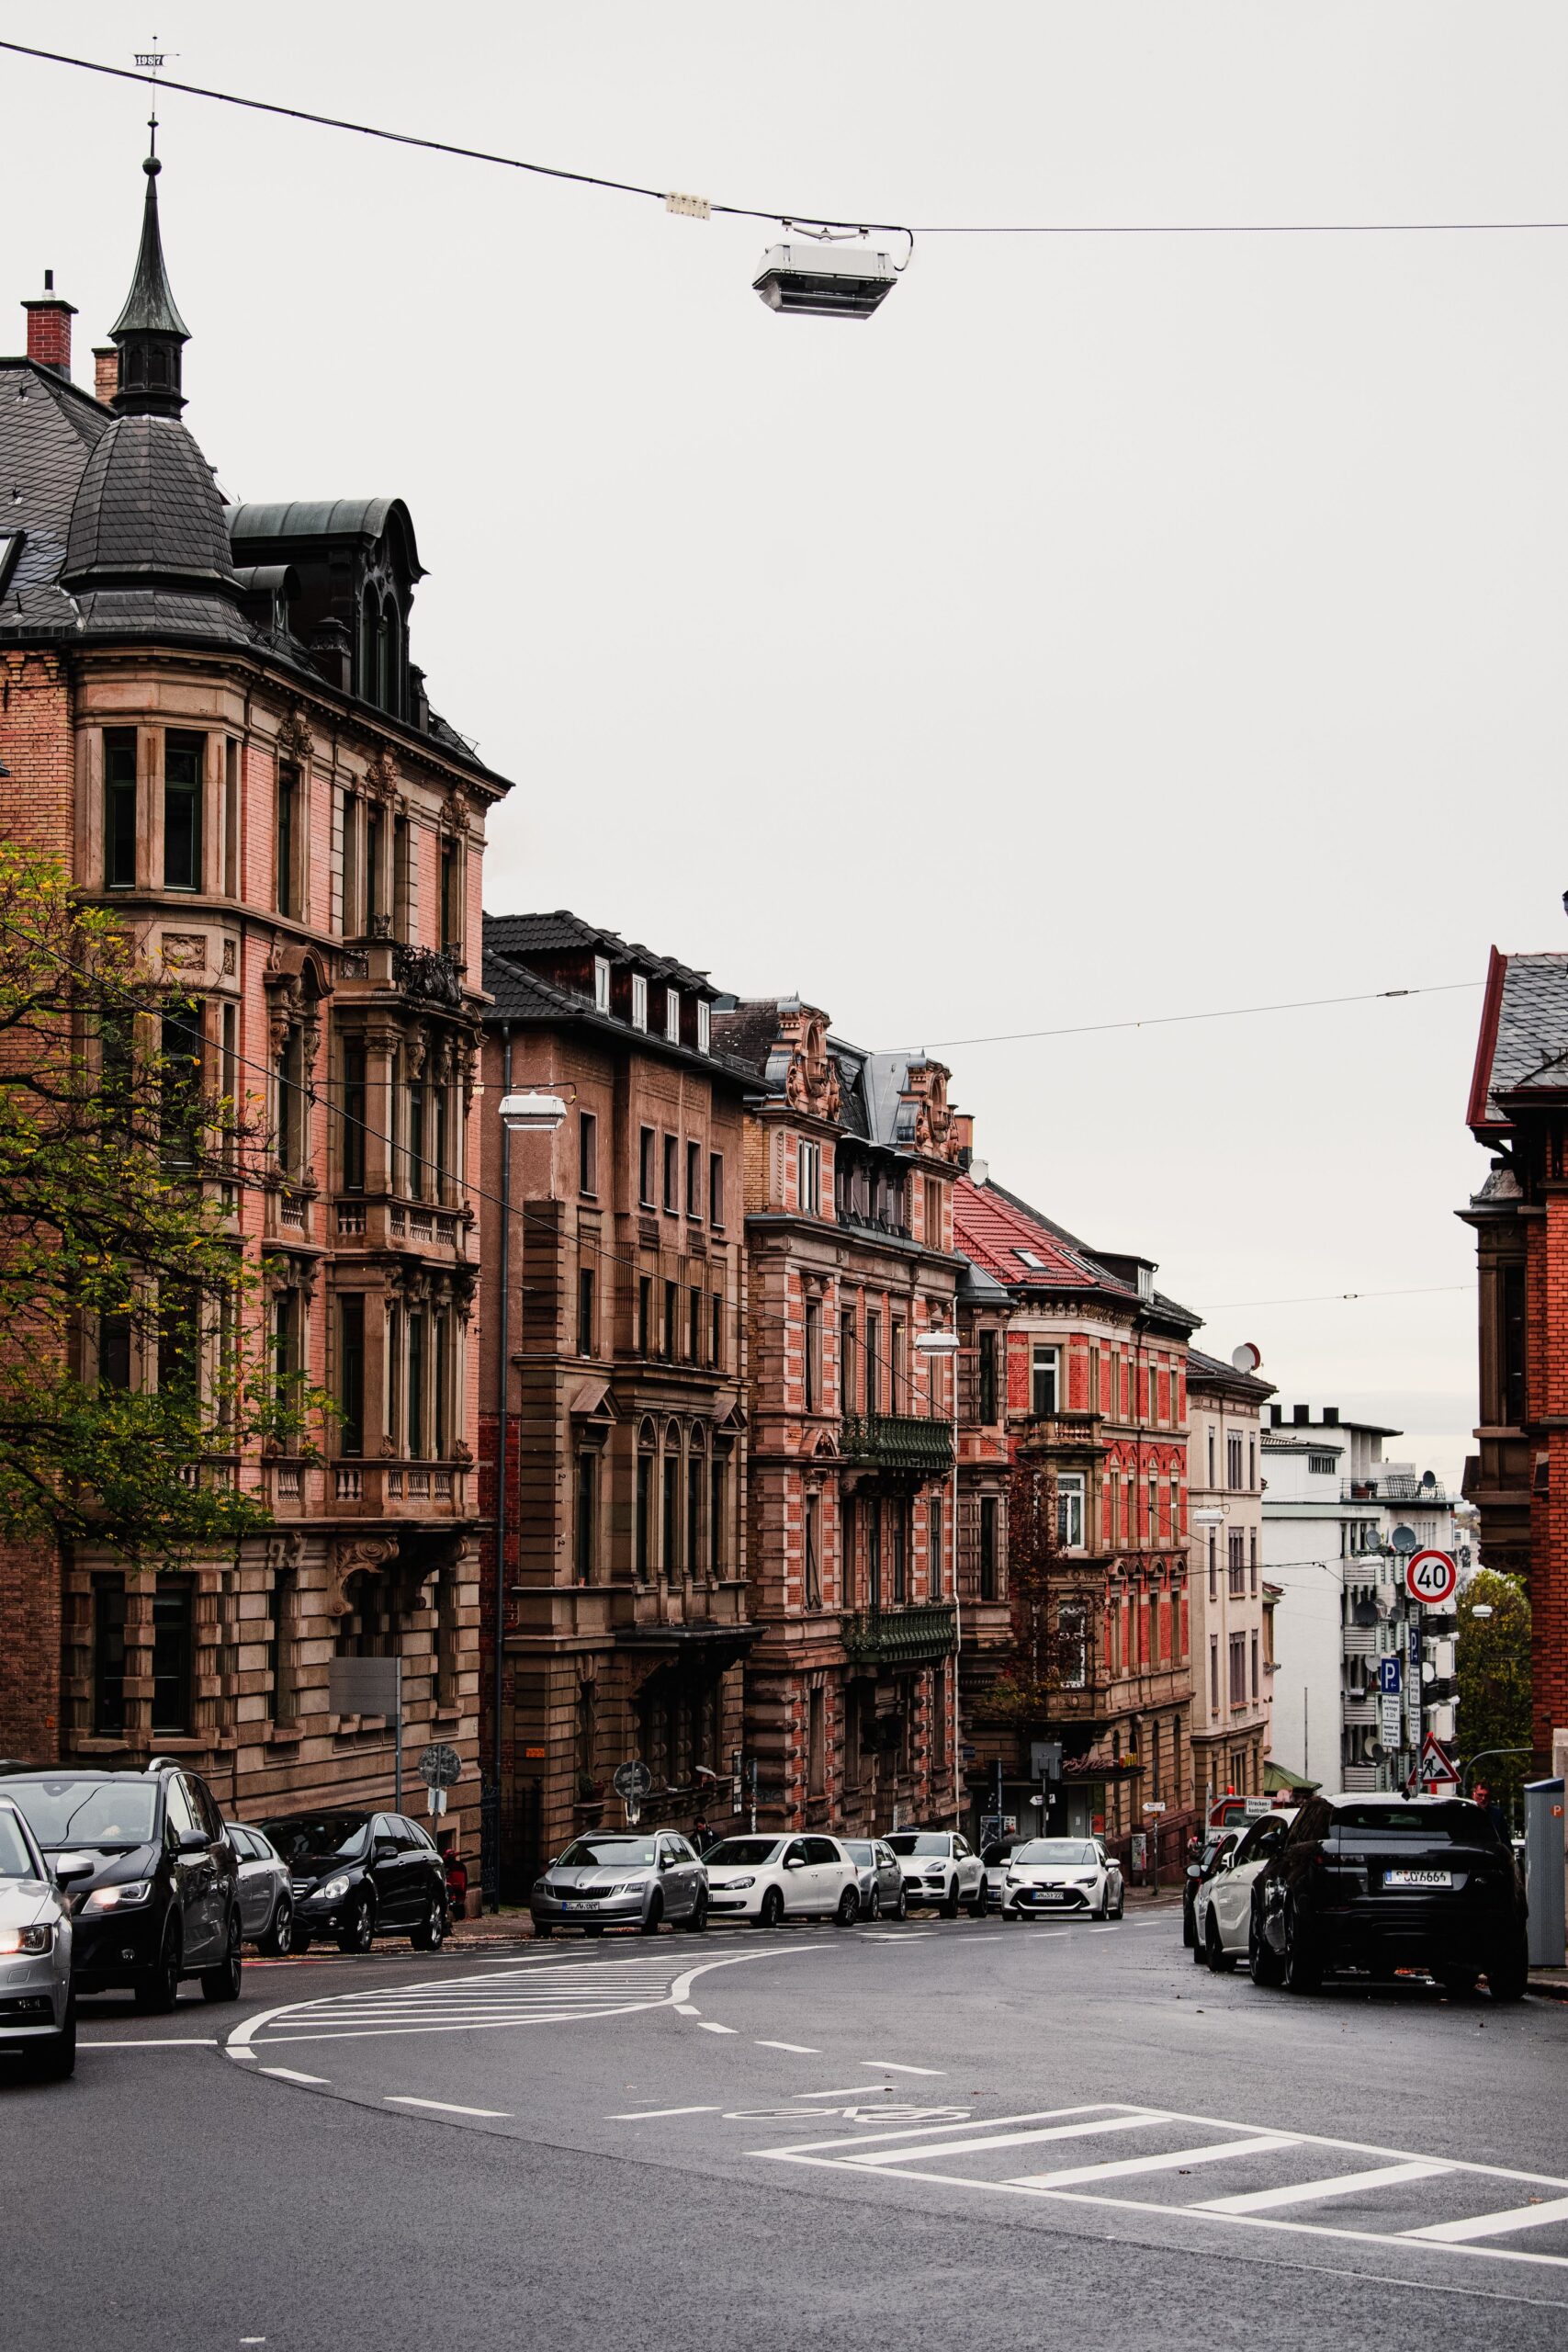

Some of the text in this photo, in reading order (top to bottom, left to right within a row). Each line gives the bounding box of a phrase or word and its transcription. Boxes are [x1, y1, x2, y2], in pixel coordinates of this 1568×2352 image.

[1417, 1565, 1446, 1589] 40
[1411, 1633, 1417, 1660] P
[1385, 1662, 1395, 1690] P
[1553, 1804, 1562, 1816] P
